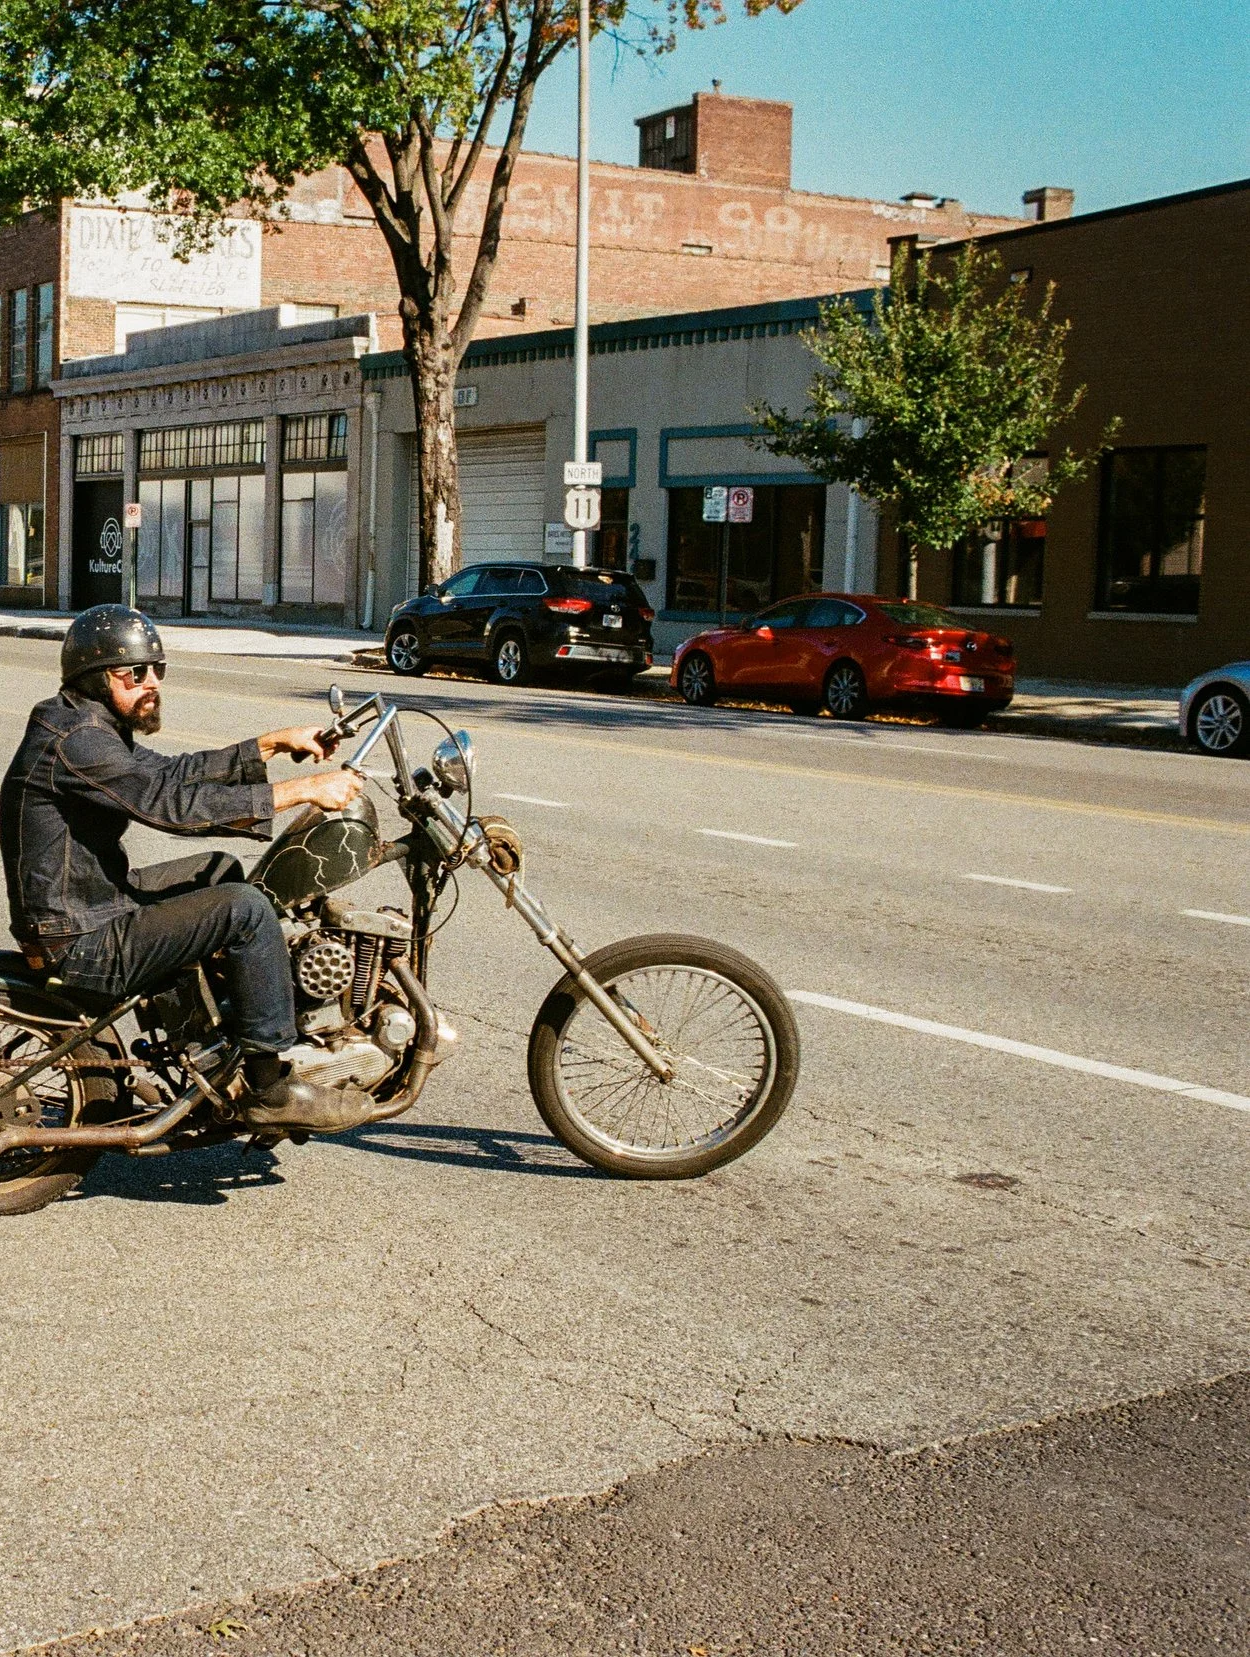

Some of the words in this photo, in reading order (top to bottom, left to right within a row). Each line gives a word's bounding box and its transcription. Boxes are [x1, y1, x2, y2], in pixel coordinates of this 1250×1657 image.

[79, 215, 142, 251] DIXIE
[567, 467, 599, 479] NORTH
[574, 497, 592, 520] 11
